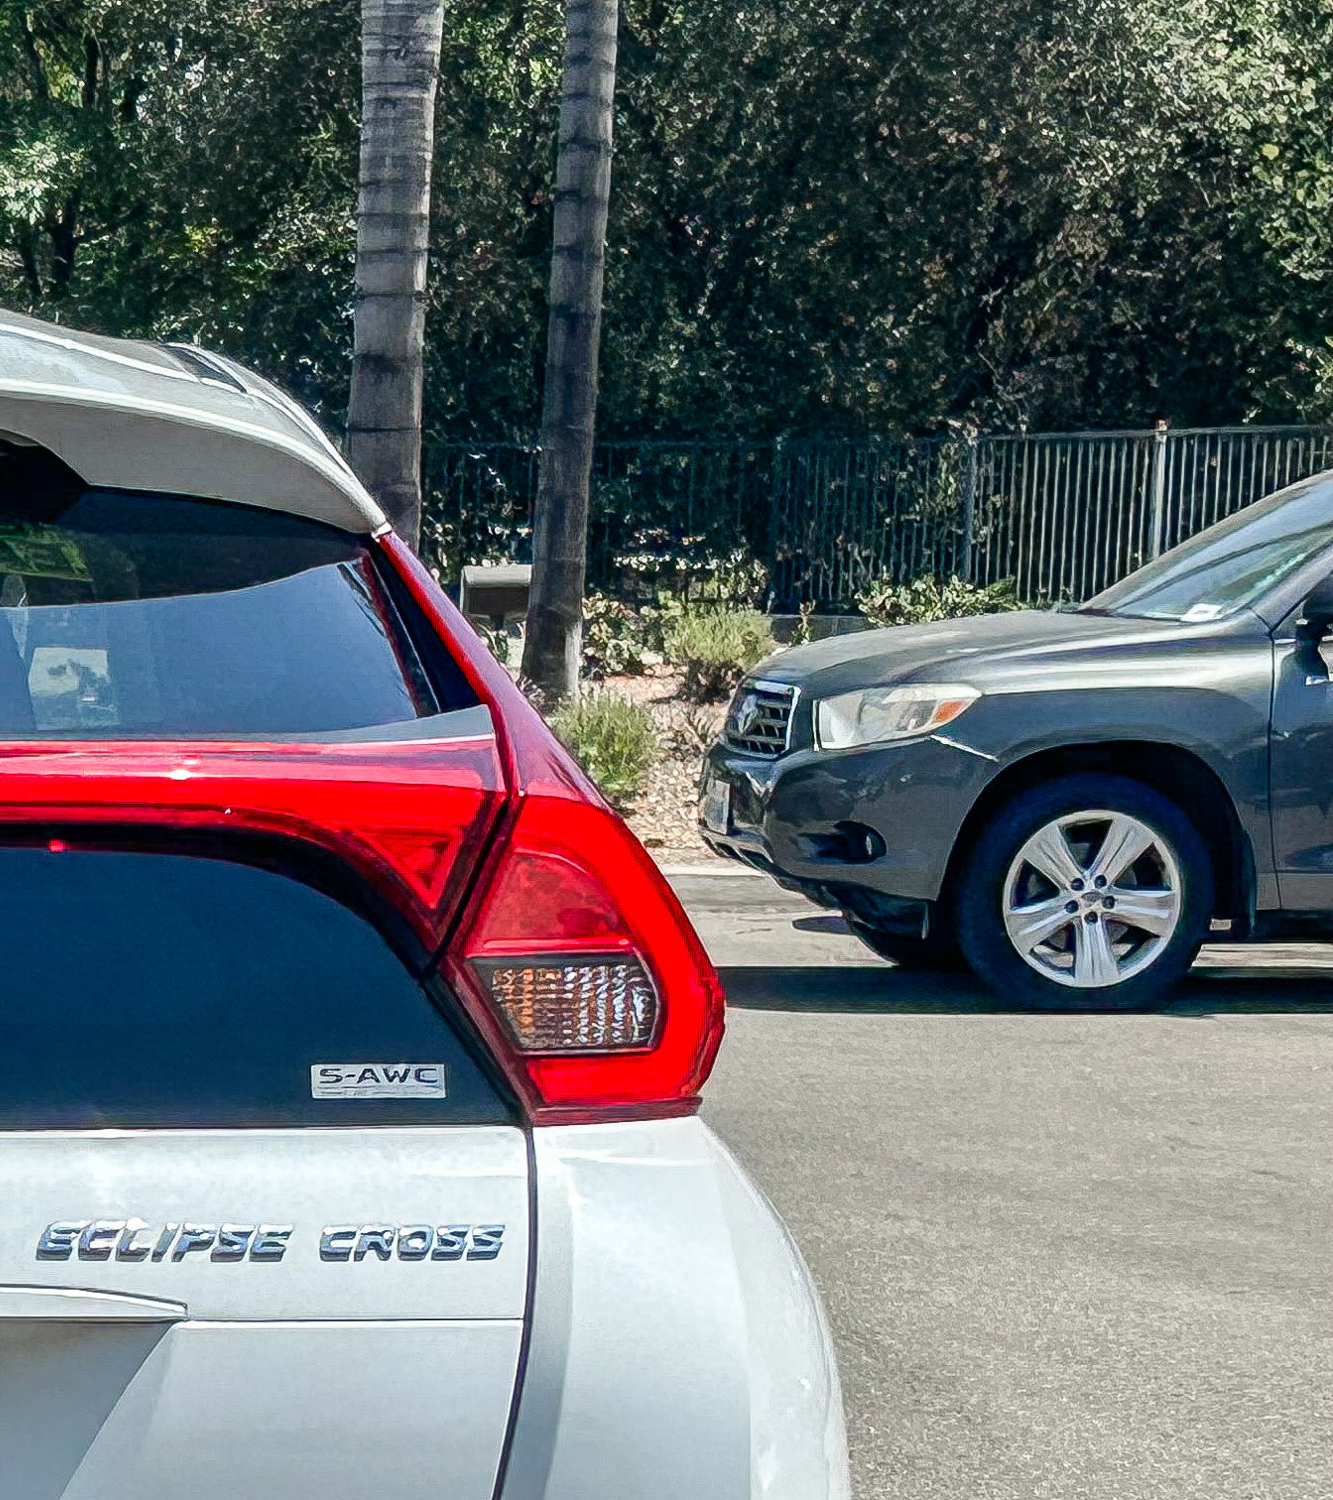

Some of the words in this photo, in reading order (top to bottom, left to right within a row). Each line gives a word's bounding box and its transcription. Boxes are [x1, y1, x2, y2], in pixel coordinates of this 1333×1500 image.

[319, 1067, 438, 1085] S-AWC
[35, 1218, 294, 1263] ECLIPSE
[318, 1223, 507, 1263] CROSS
